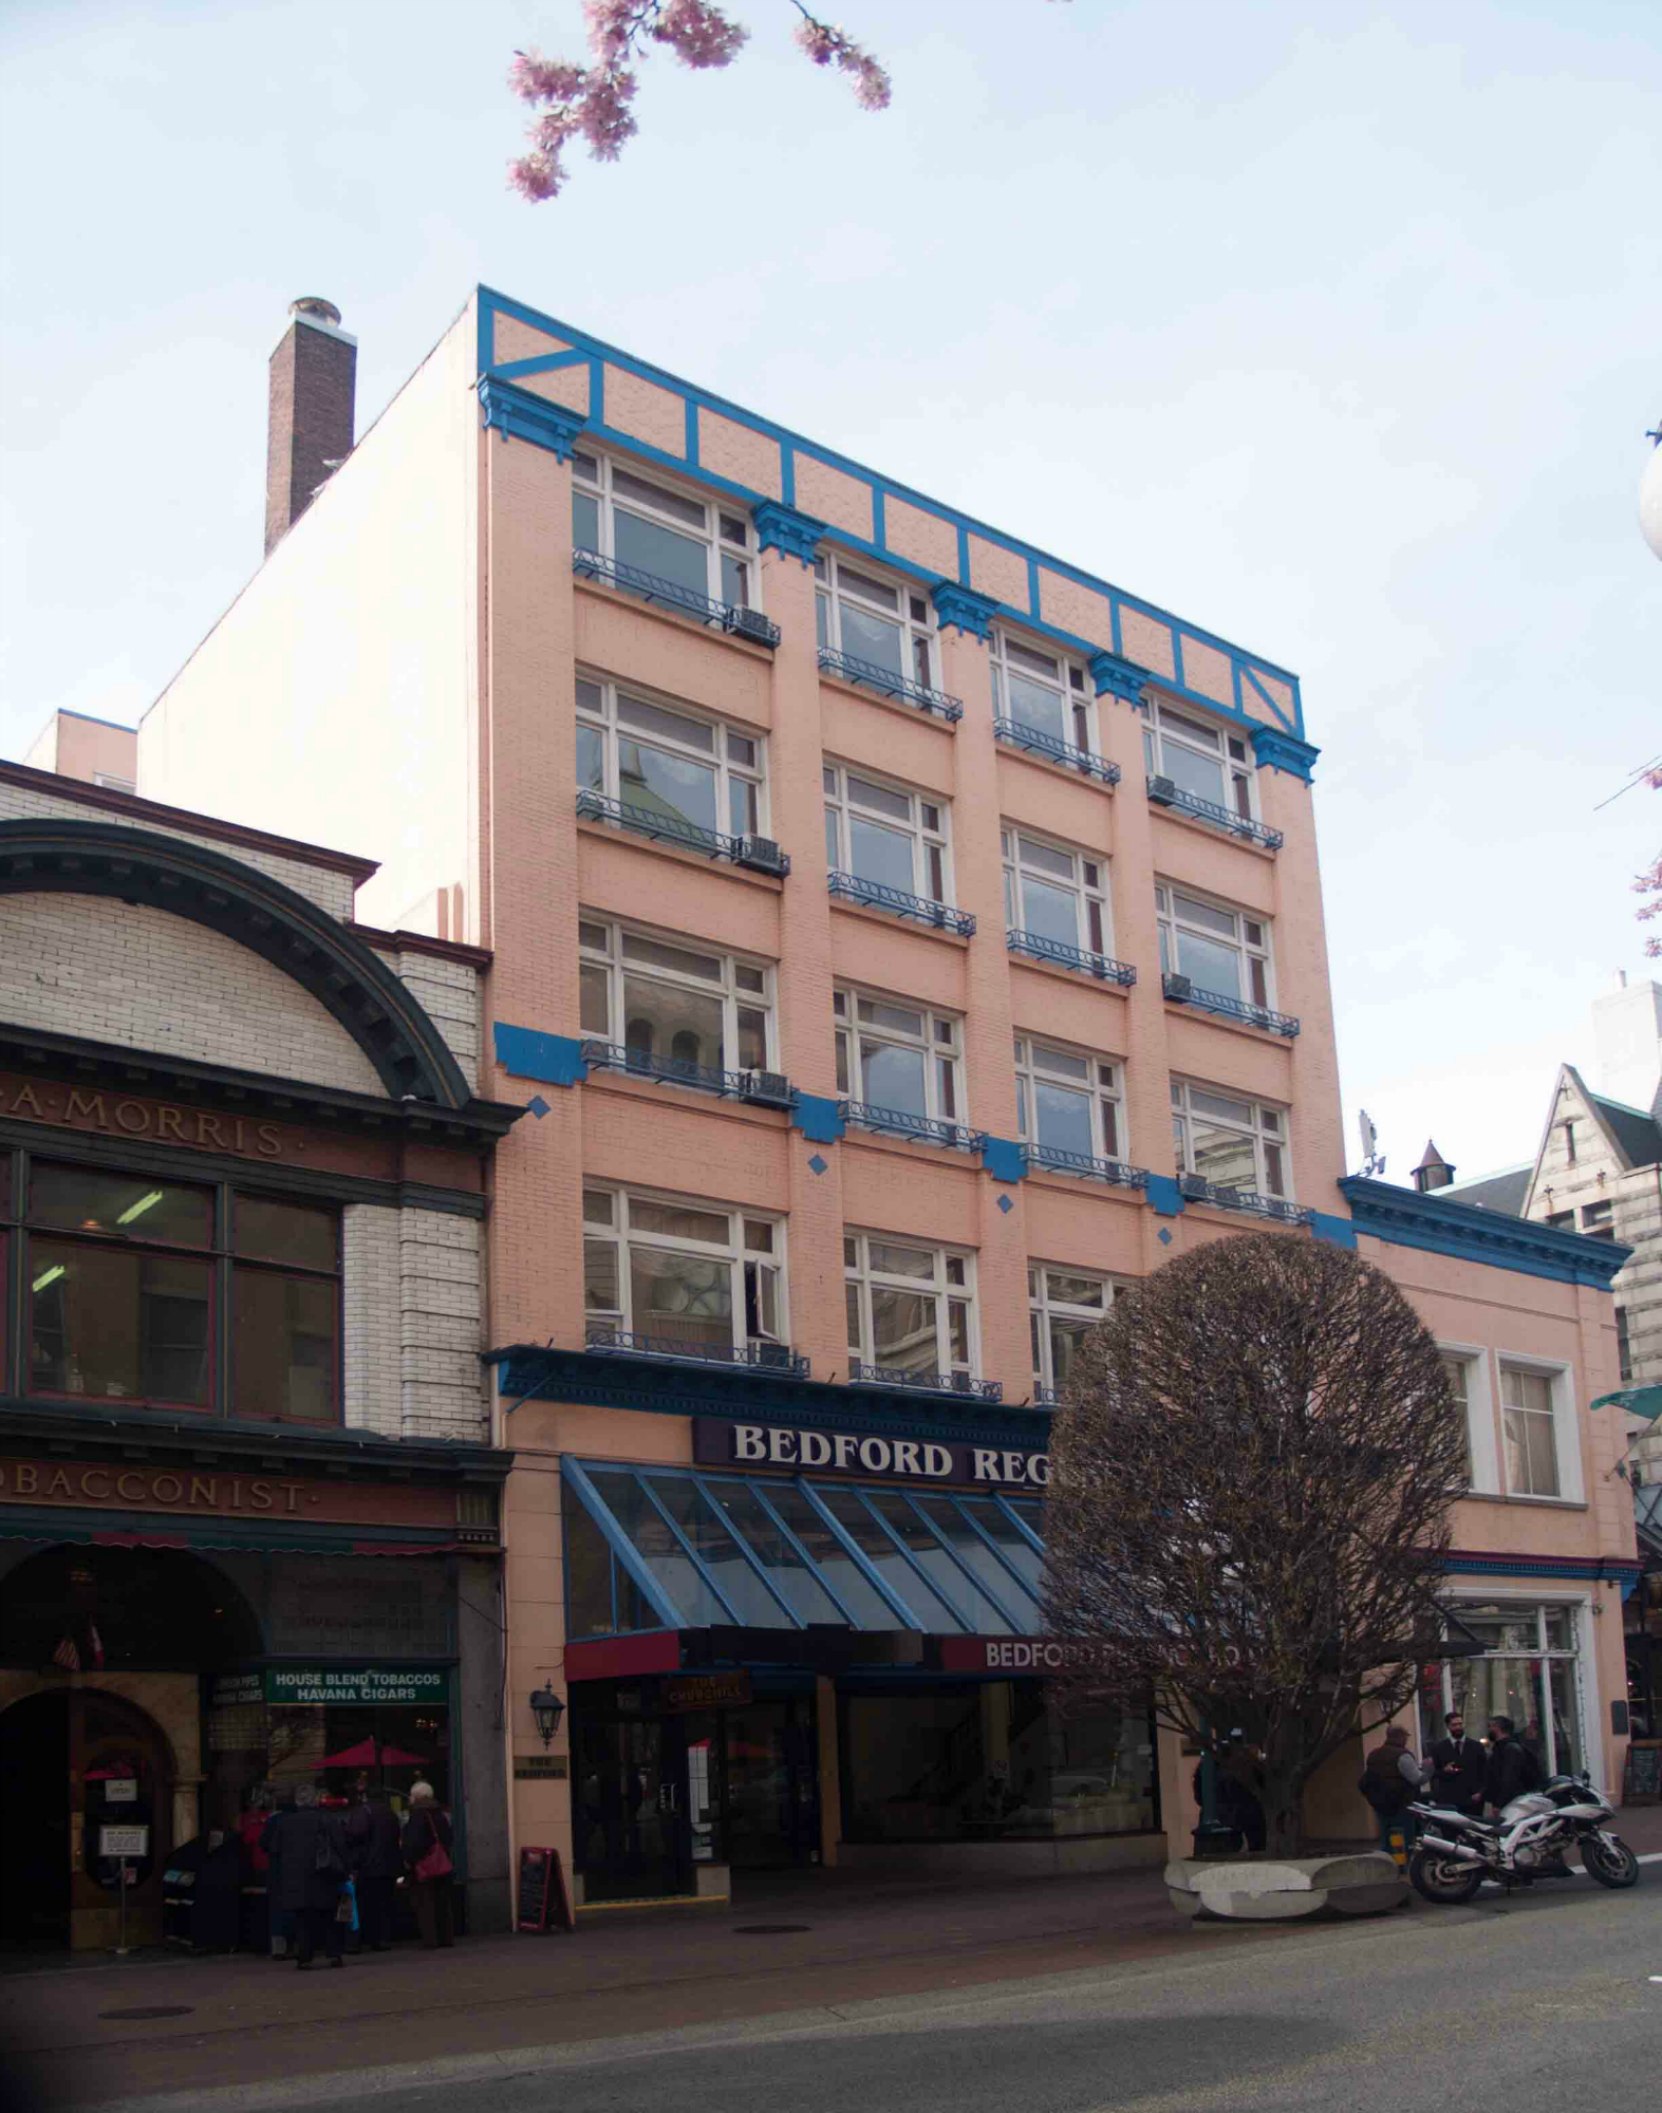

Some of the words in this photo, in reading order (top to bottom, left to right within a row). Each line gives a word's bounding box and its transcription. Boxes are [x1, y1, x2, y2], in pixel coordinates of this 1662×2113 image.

[63, 1090, 284, 1156] MORRIS
[733, 1424, 953, 1477] BEDFORD
[0, 1463, 304, 1511] BACCONIST
[275, 1673, 322, 1686] HOUSE
[325, 1673, 369, 1687] BLEND
[371, 1673, 441, 1687] TOBACCOS
[297, 1687, 357, 1701] HAVANA
[360, 1687, 417, 1701] CIGARS
